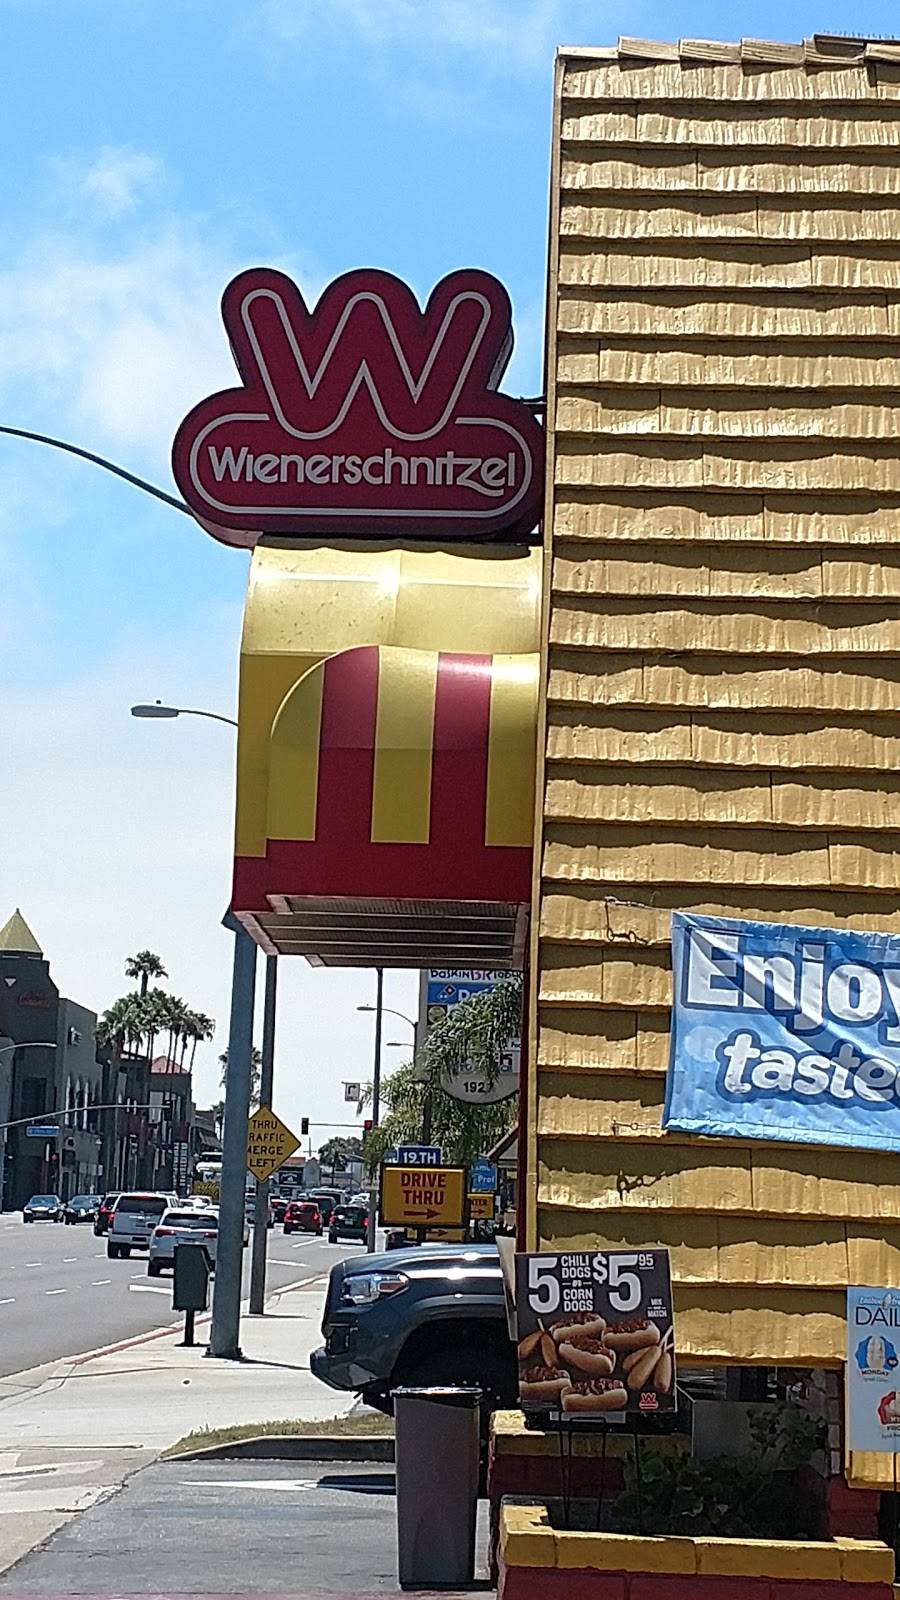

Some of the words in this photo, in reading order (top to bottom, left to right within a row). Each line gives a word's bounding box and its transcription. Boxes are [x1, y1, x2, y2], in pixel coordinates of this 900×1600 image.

[241, 289, 491, 440] W
[207, 446, 516, 497] Wienerschnitzel
[724, 1032, 900, 1102] taste
[252, 1120, 278, 1129] THRU
[249, 1133, 285, 1142] RAFFIC
[250, 1158, 276, 1167] LEFT
[401, 1173, 447, 1187] DRIVE
[403, 1190, 445, 1205] THRU
[561, 1255, 589, 1267] CHILI
[562, 1267, 591, 1279] DOGS
[528, 1257, 560, 1314] 5
[563, 1288, 593, 1300] CORN
[564, 1300, 593, 1312] DOGS
[856, 1306, 900, 1327] DAIL
